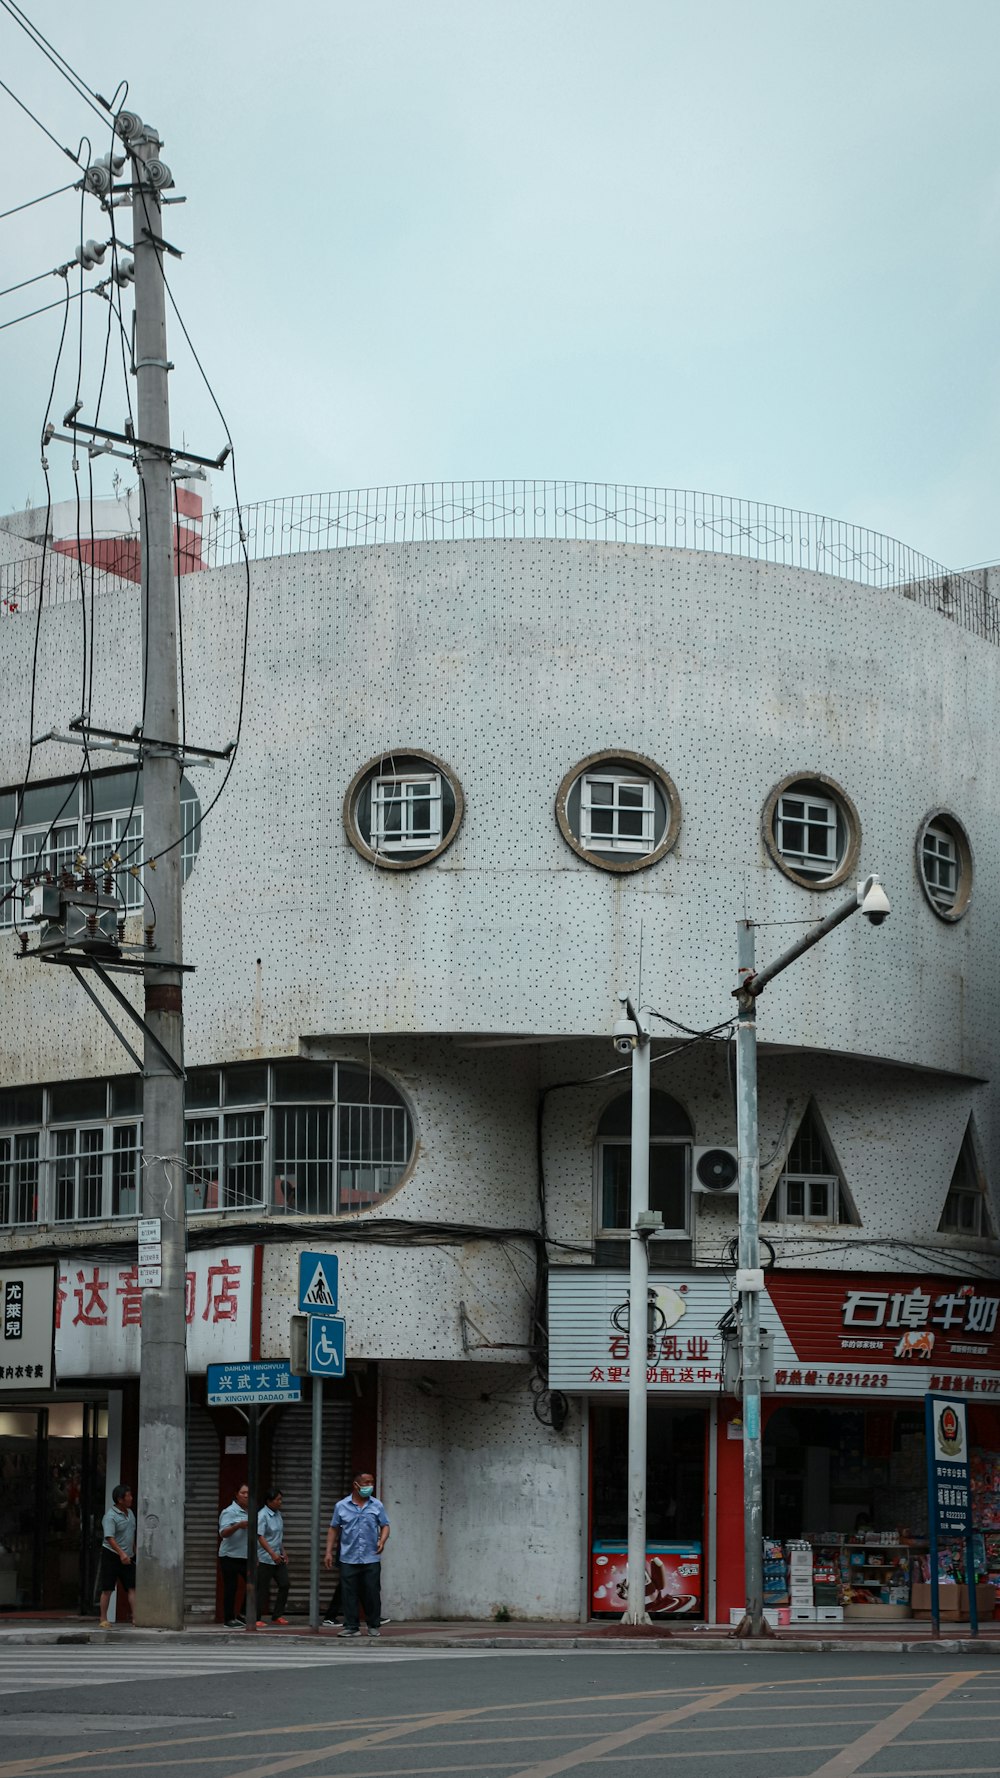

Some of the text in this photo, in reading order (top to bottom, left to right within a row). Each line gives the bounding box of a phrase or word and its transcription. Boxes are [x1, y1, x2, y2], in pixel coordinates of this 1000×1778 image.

[6, 1284, 22, 1337] 尤萊兒
[841, 1286, 1000, 1333] 石埠牛奶
[608, 1335, 709, 1360] 石乳业
[218, 1372, 290, 1391] 兴武大道
